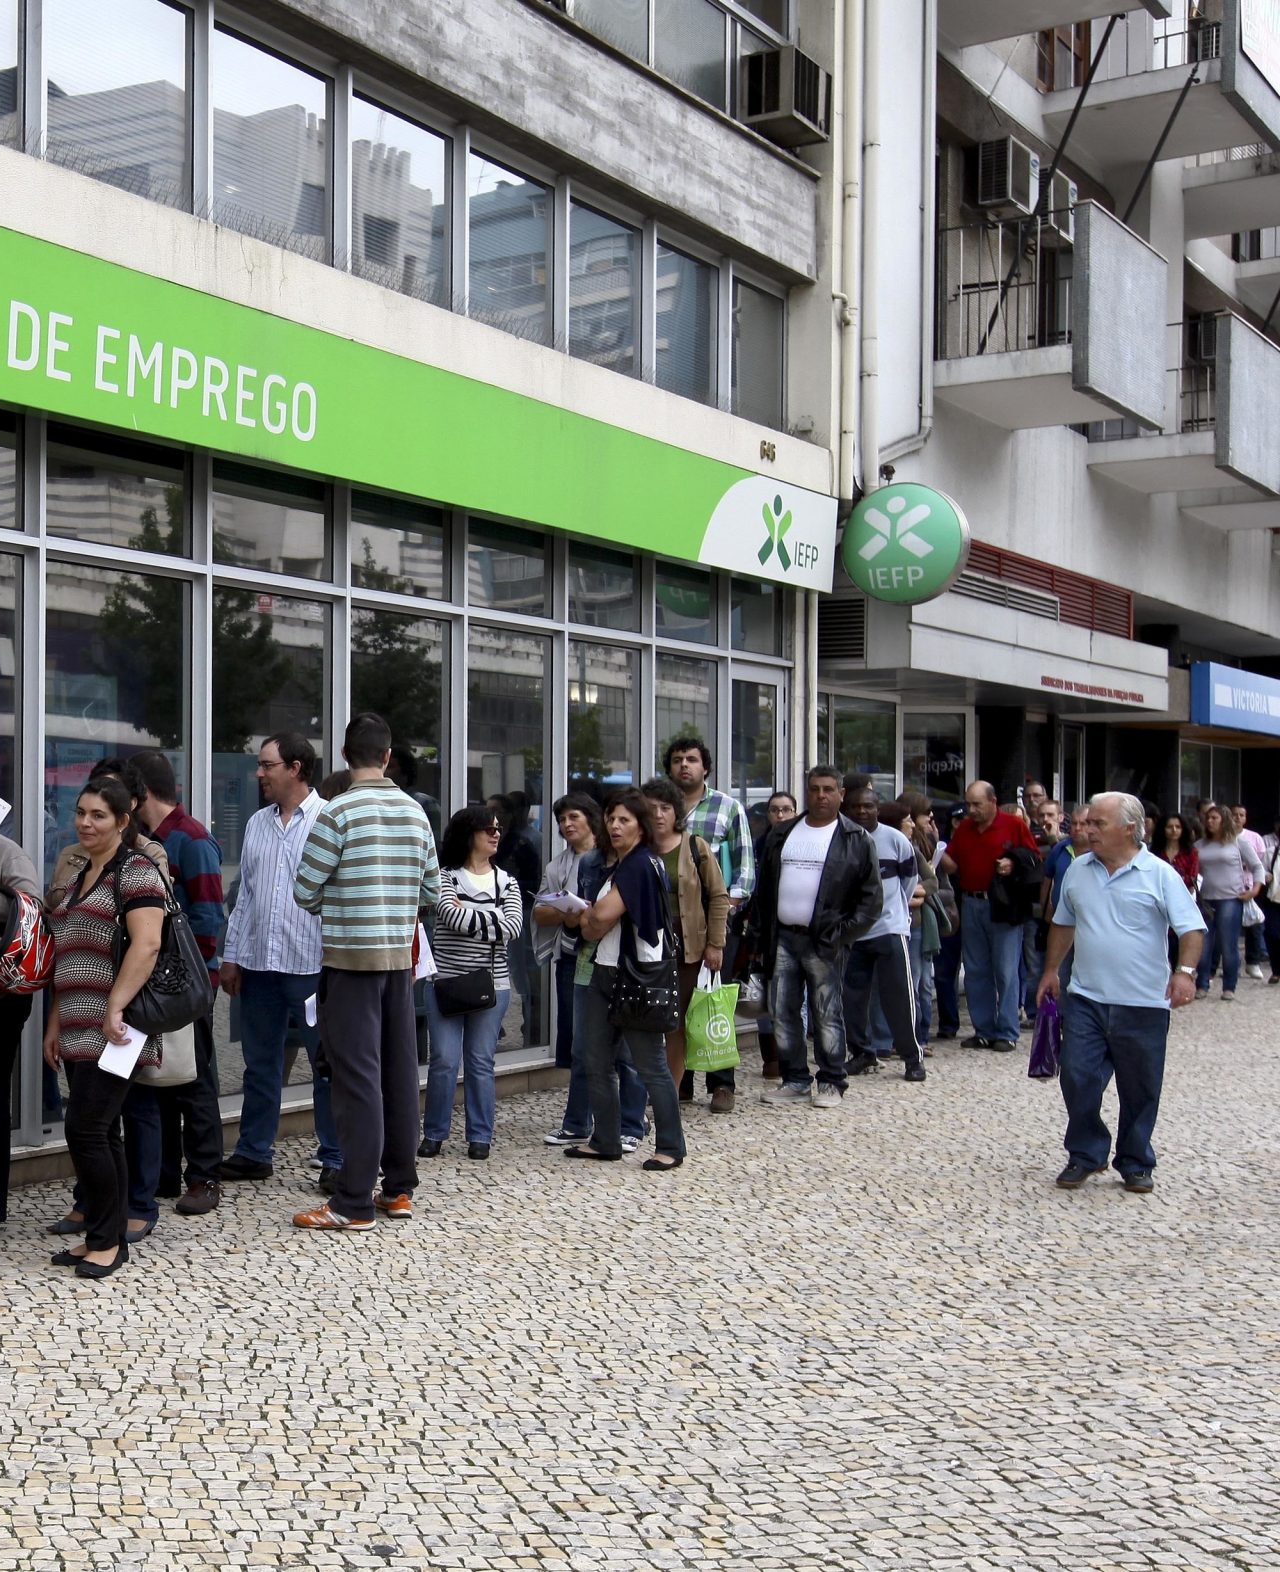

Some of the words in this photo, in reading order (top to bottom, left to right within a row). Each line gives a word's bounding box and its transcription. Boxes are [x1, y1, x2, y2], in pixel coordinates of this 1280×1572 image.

[7, 300, 75, 383] DE
[95, 325, 318, 442] EMPREGO
[794, 541, 819, 570] IEFP
[868, 566, 924, 590] IEFP
[1232, 687, 1268, 715] VICTORIA
[710, 1020, 729, 1039] CG
